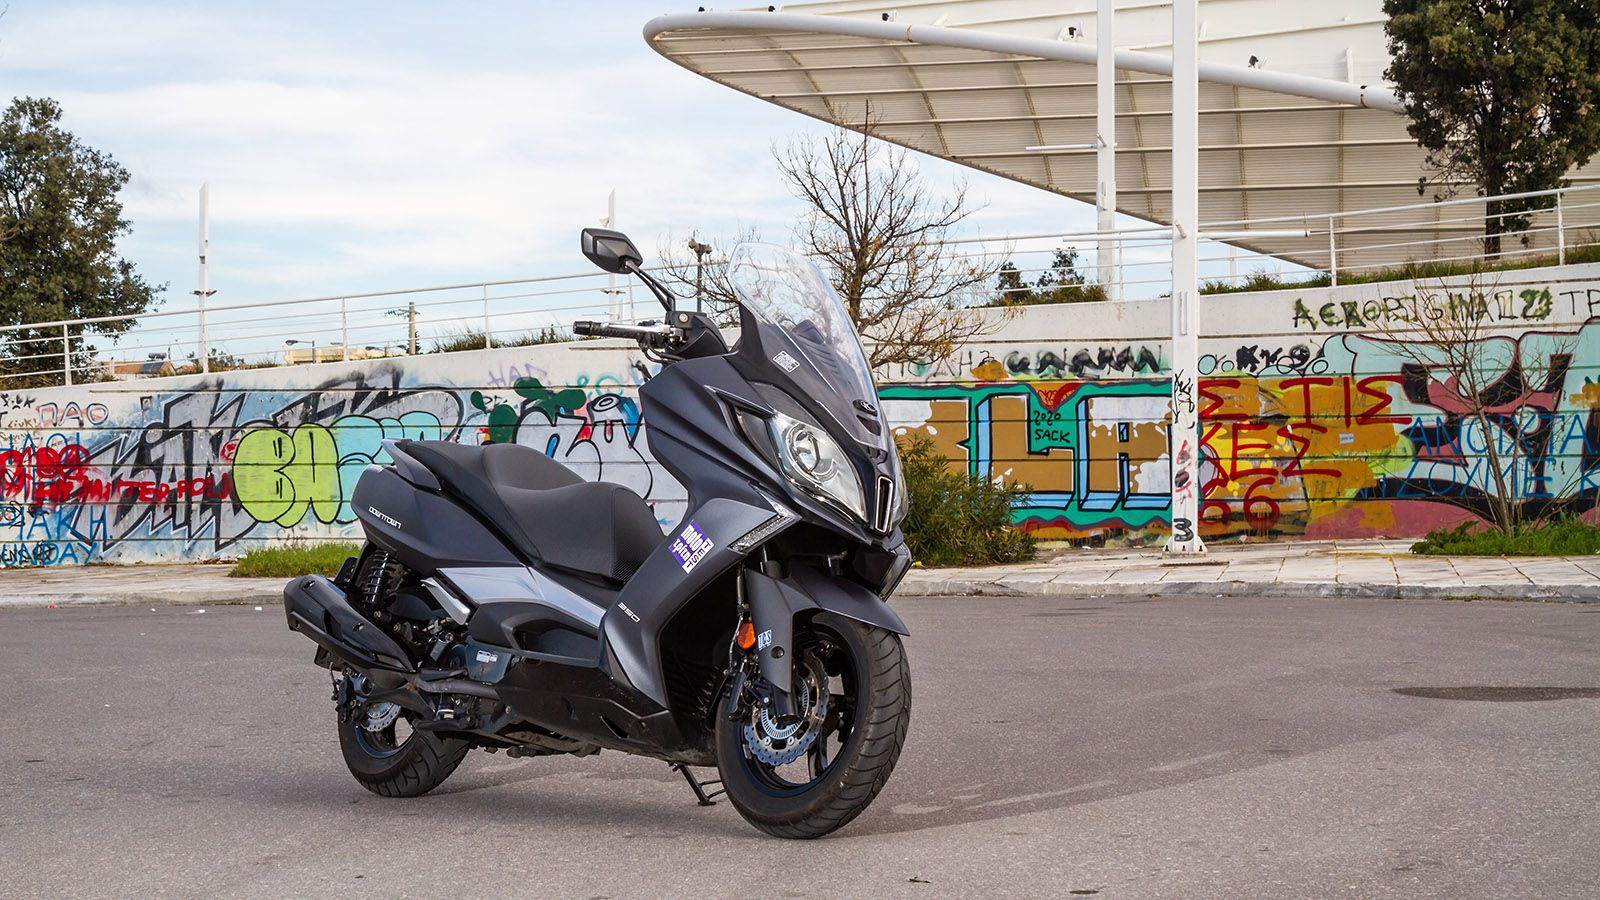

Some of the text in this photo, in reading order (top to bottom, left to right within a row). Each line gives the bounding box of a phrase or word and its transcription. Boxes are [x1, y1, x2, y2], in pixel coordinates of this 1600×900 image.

[38, 401, 109, 427] ΠΑΟ
[1033, 410, 1061, 426] 2020
[1034, 428, 1070, 443] SACK
[369, 506, 402, 529] DOWNTOWN
[681, 524, 704, 552] moto
[686, 541, 712, 568] TEST
